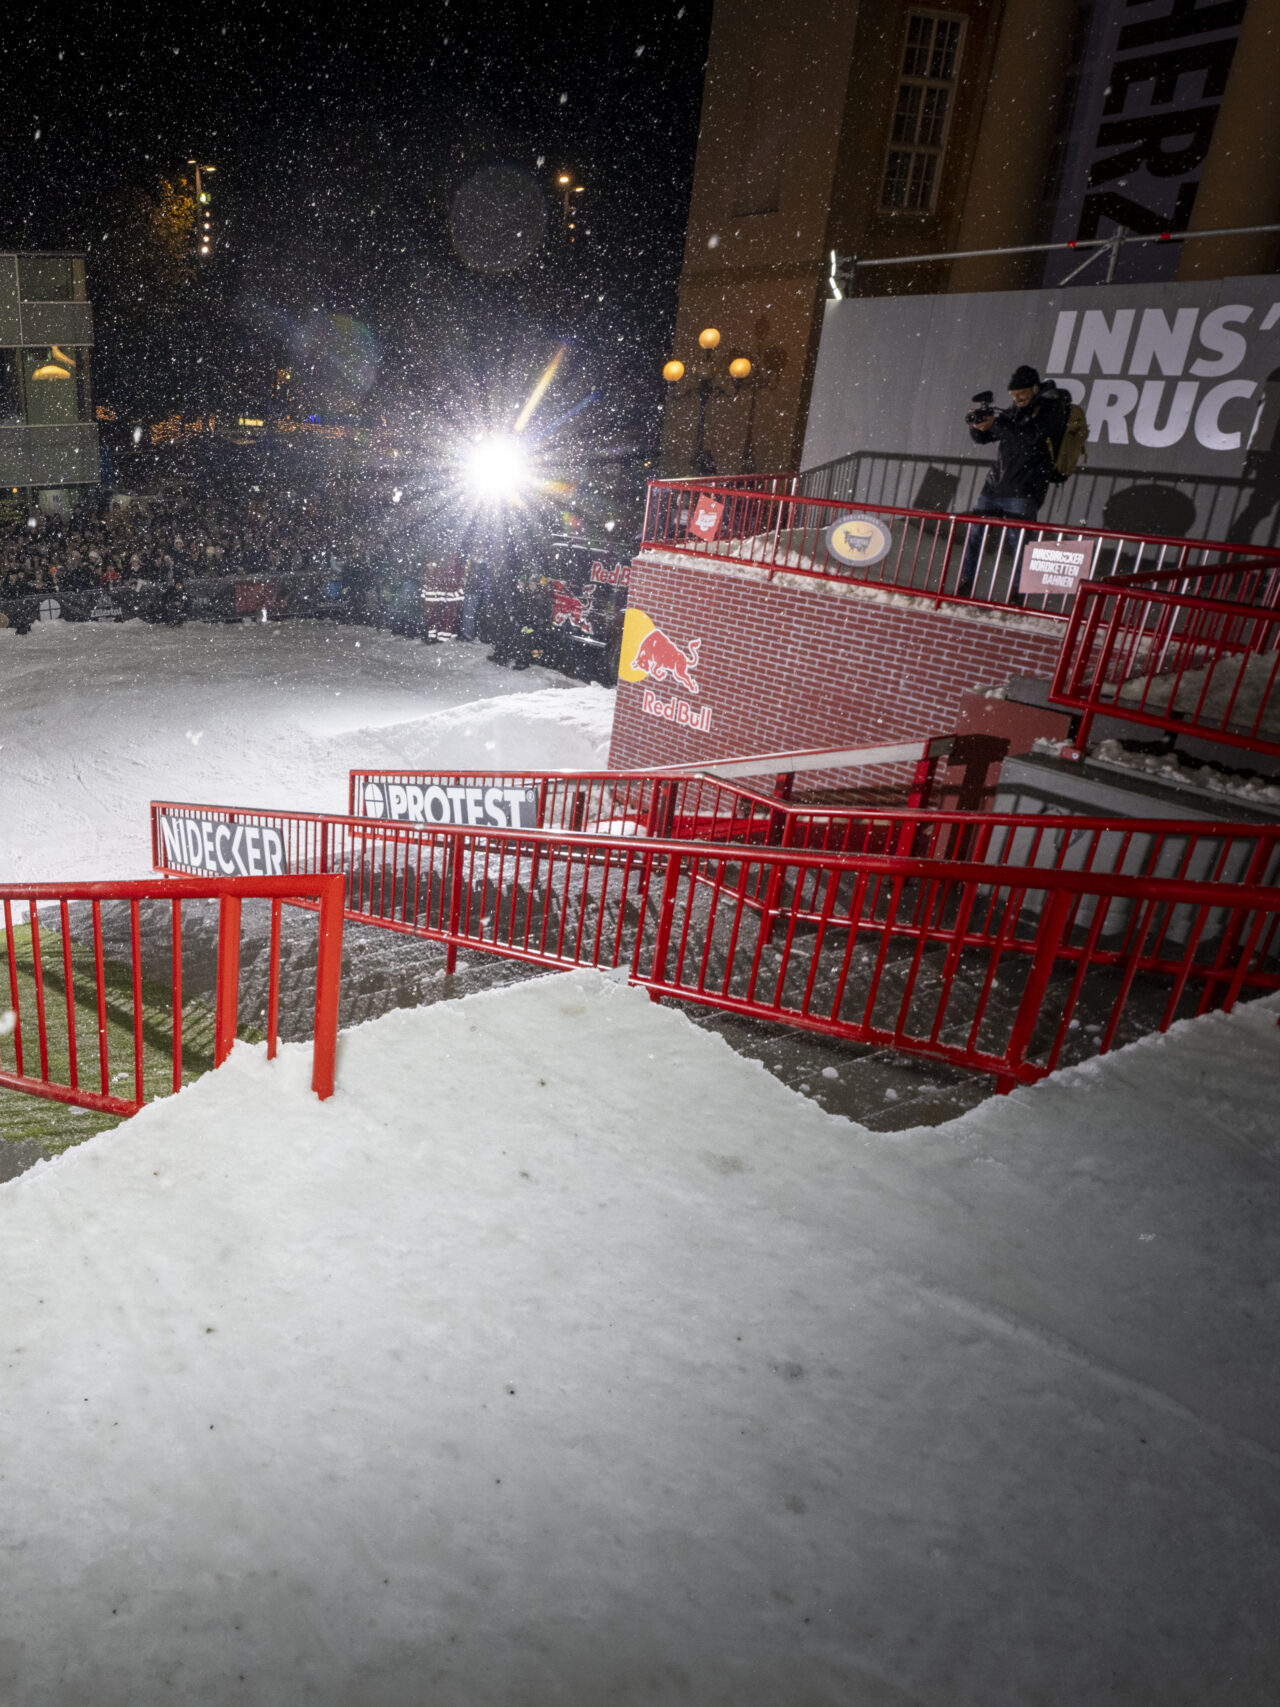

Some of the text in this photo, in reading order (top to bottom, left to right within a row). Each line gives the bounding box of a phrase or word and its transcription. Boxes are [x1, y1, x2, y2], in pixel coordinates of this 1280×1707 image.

[1042, 378, 1267, 450] RUC
[590, 561, 620, 585] Red
[1029, 560, 1080, 577] NORDKETTEN
[1042, 573, 1074, 588] BAHNEN
[642, 689, 712, 732] Red Bull
[388, 785, 525, 828] PROTEST
[161, 816, 283, 876] NIDECKER
